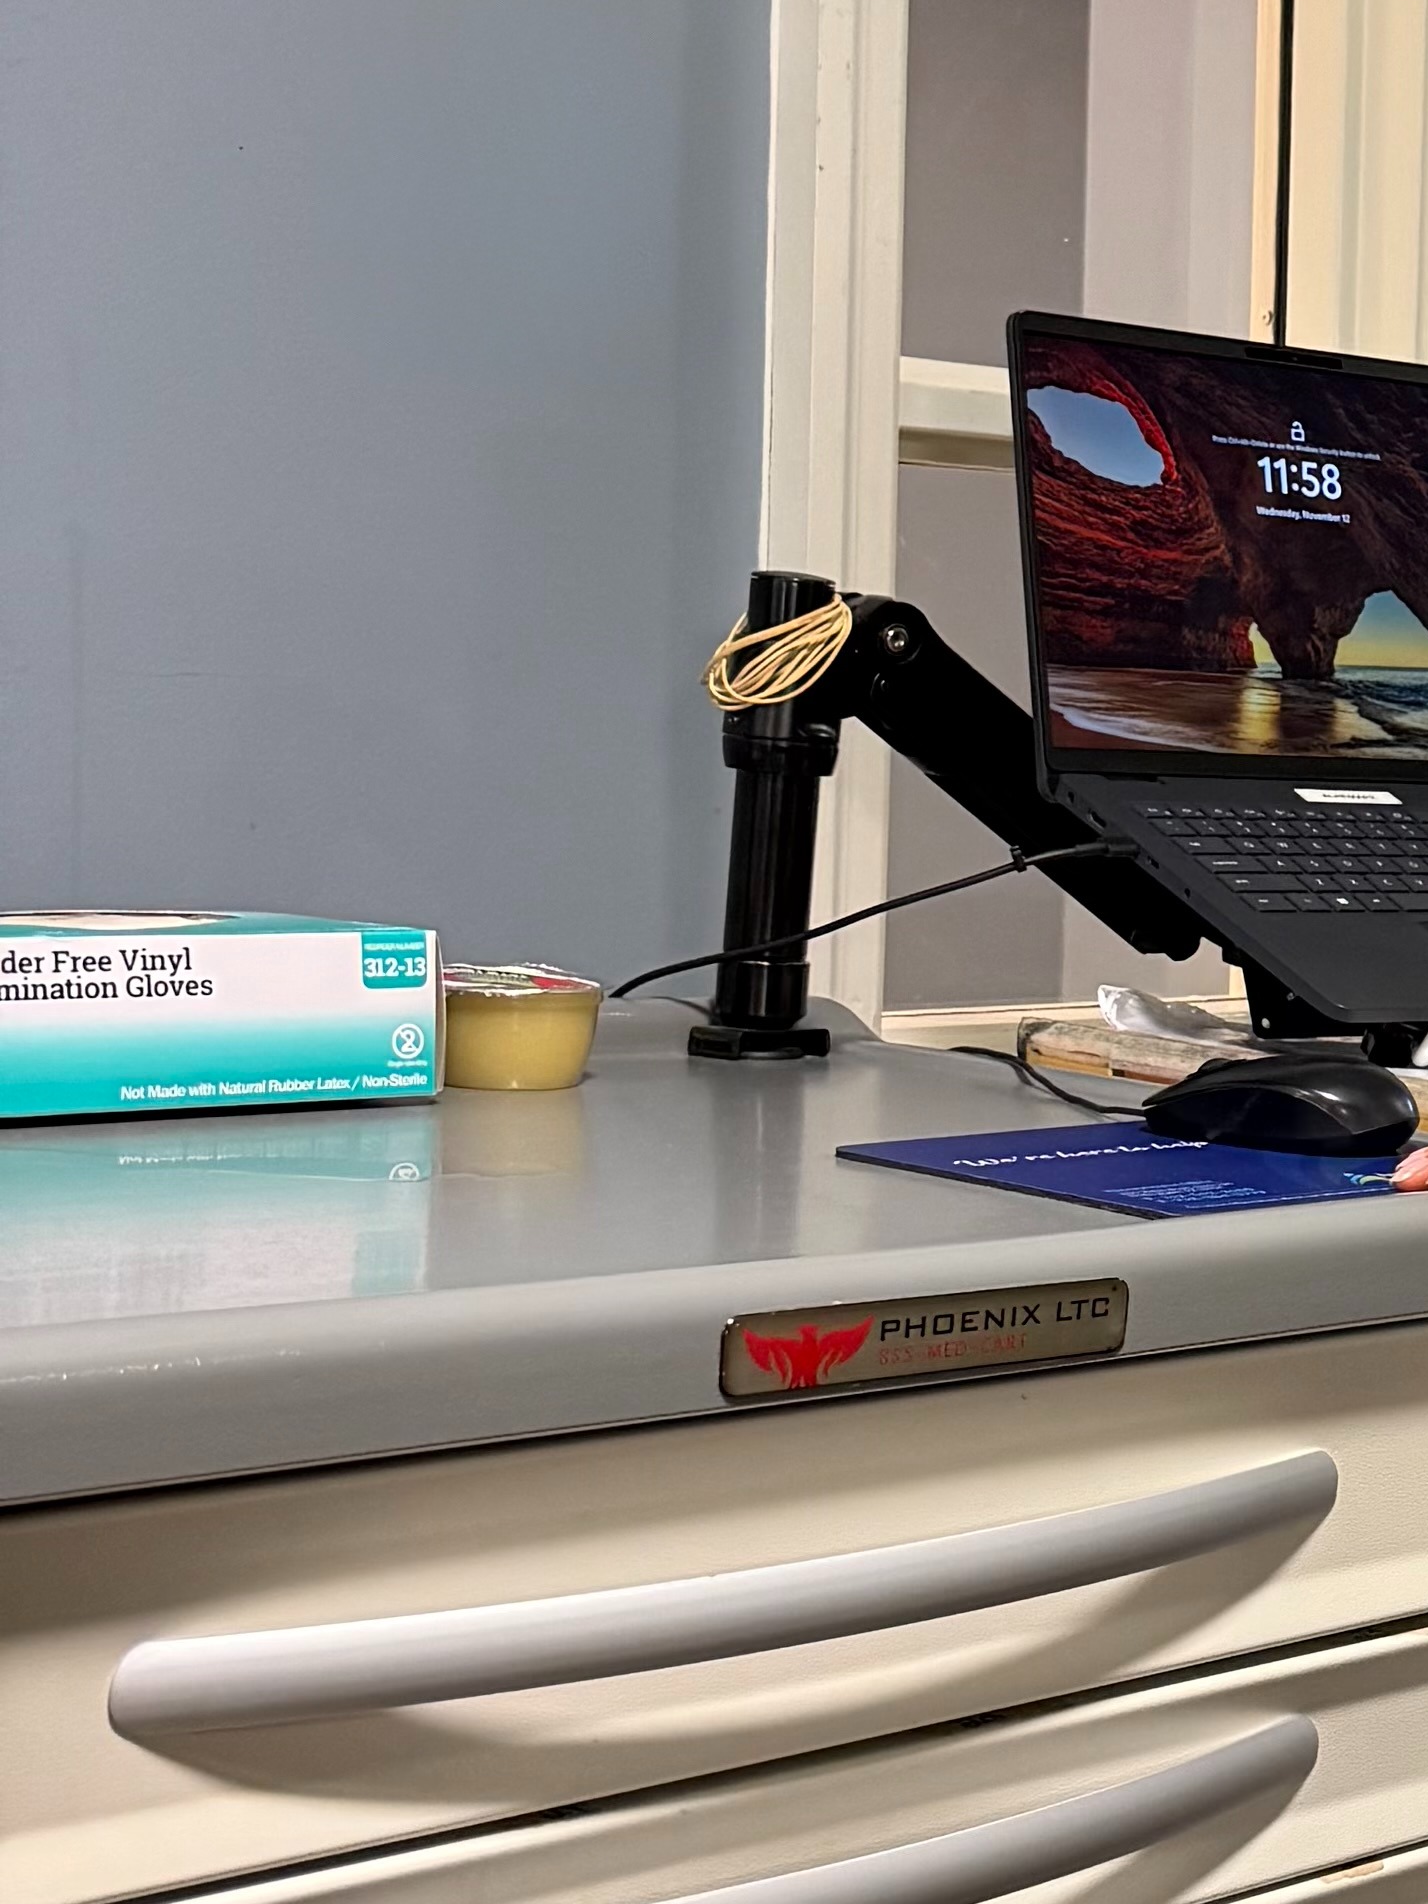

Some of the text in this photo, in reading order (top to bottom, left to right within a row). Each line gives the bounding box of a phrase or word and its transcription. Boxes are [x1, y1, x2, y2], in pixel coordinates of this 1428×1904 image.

[1257, 456, 1342, 500] 11:58
[0, 947, 192, 976] der Free Vinyl
[363, 957, 426, 977] 312-13
[126, 974, 213, 997] Gloves
[120, 1085, 145, 1100] Not
[147, 1084, 187, 1098] Made
[189, 1082, 216, 1096] with
[219, 1080, 266, 1094] Natural
[268, 1078, 315, 1093] Rubber
[317, 1077, 350, 1090] Latex
[362, 1072, 428, 1088] Non-Sterile
[880, 1297, 1110, 1342] PHOENIX LTC
